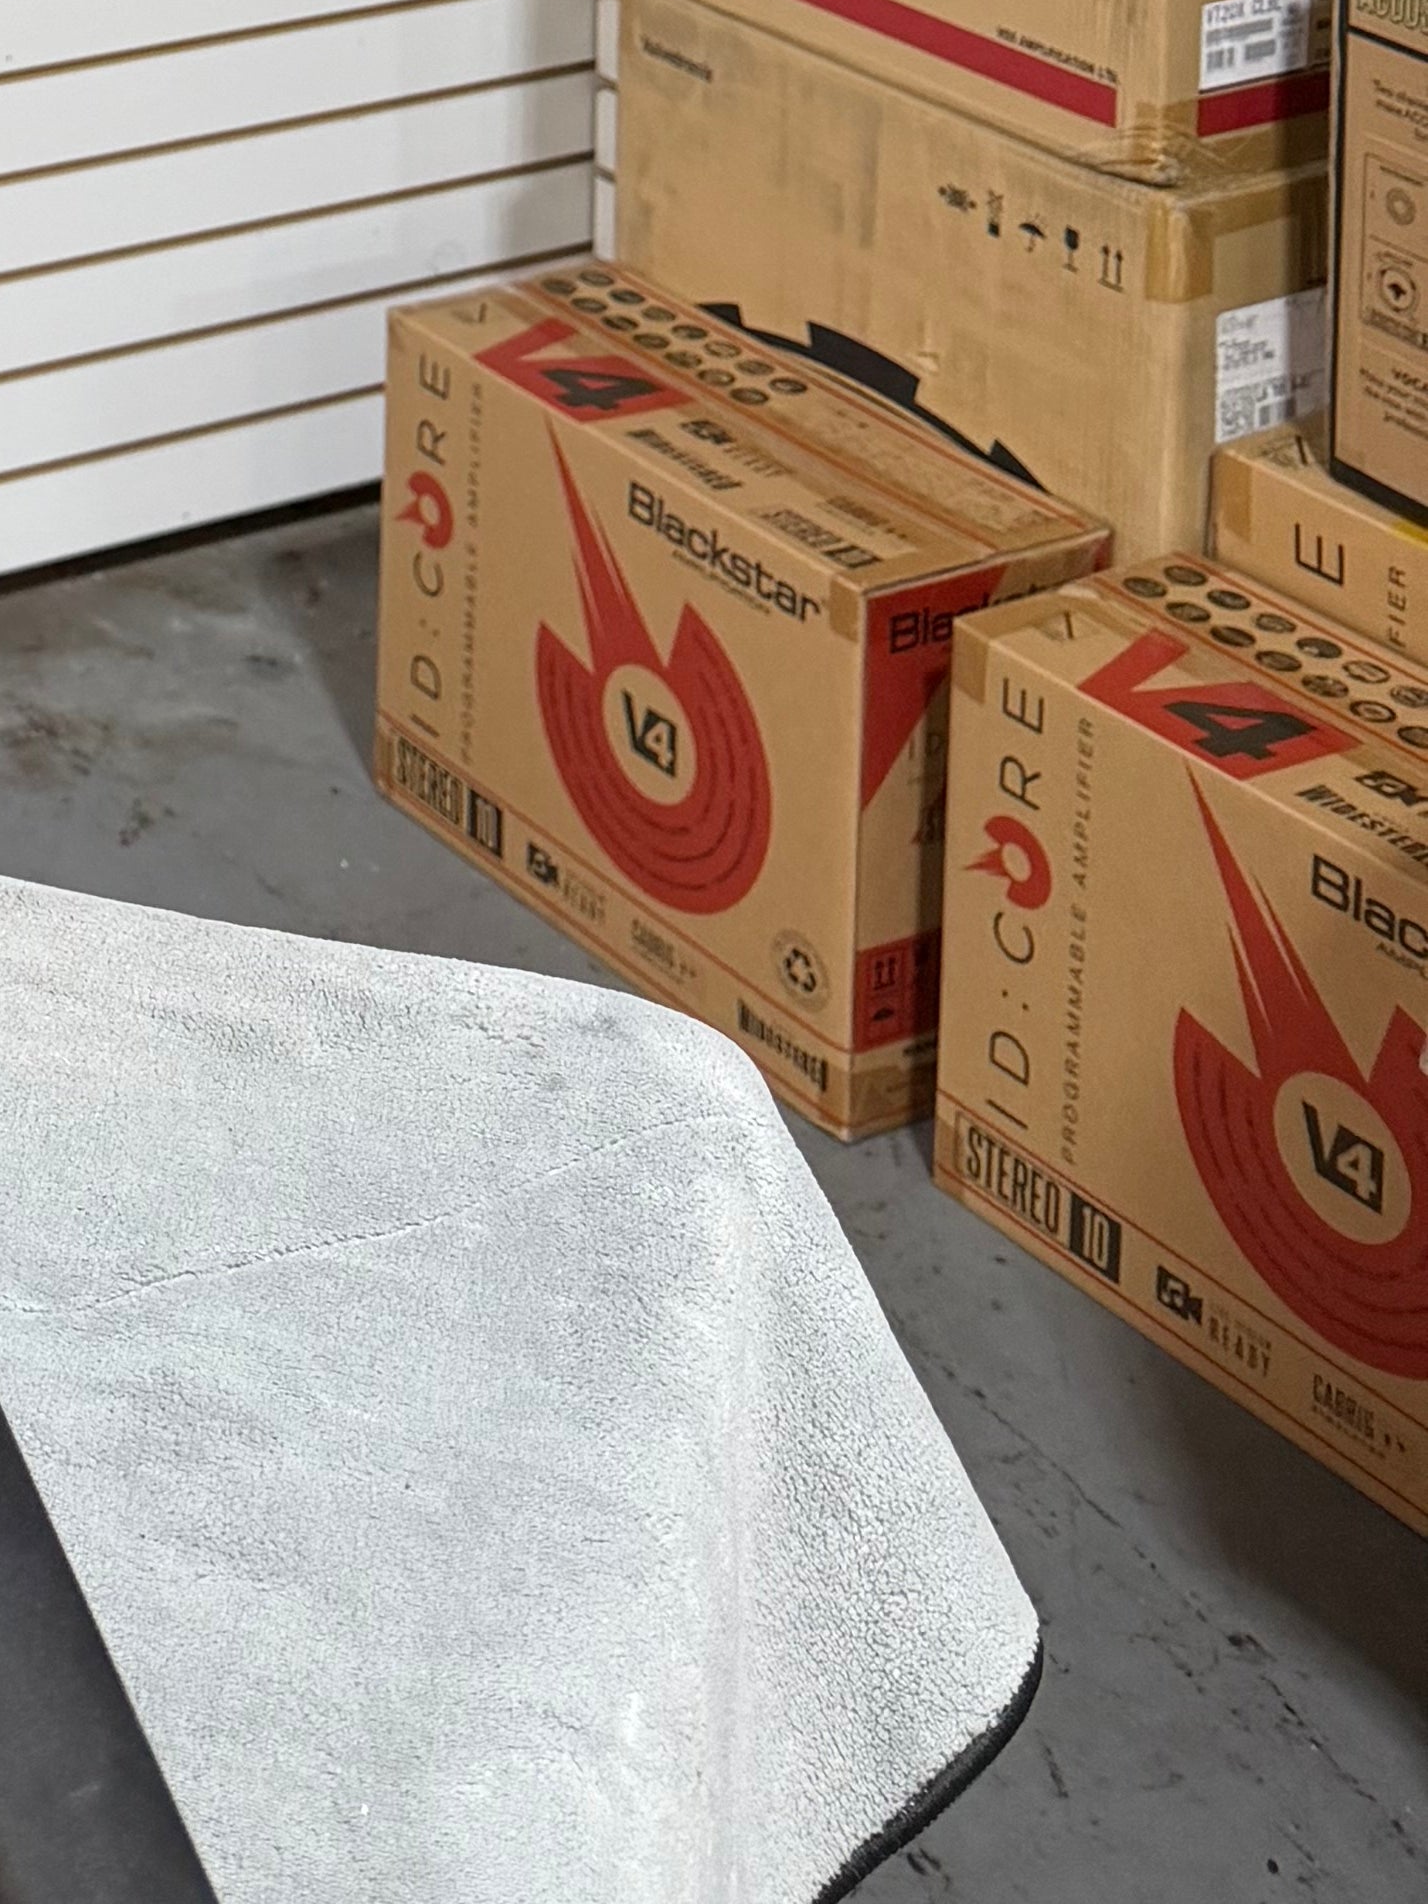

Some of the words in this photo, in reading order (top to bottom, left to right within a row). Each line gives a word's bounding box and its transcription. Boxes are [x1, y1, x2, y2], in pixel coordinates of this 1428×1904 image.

[627, 480, 822, 625] Blackstar
[1077, 626, 1364, 780] V4
[393, 737, 464, 826] STEREO
[1070, 717, 1094, 889] AMPLIFIER
[1059, 905, 1088, 1167] PROGRAMMABLE
[965, 1124, 1061, 1236] STEREO
[1081, 1203, 1110, 1271] 10
[1302, 1100, 1385, 1215] V4
